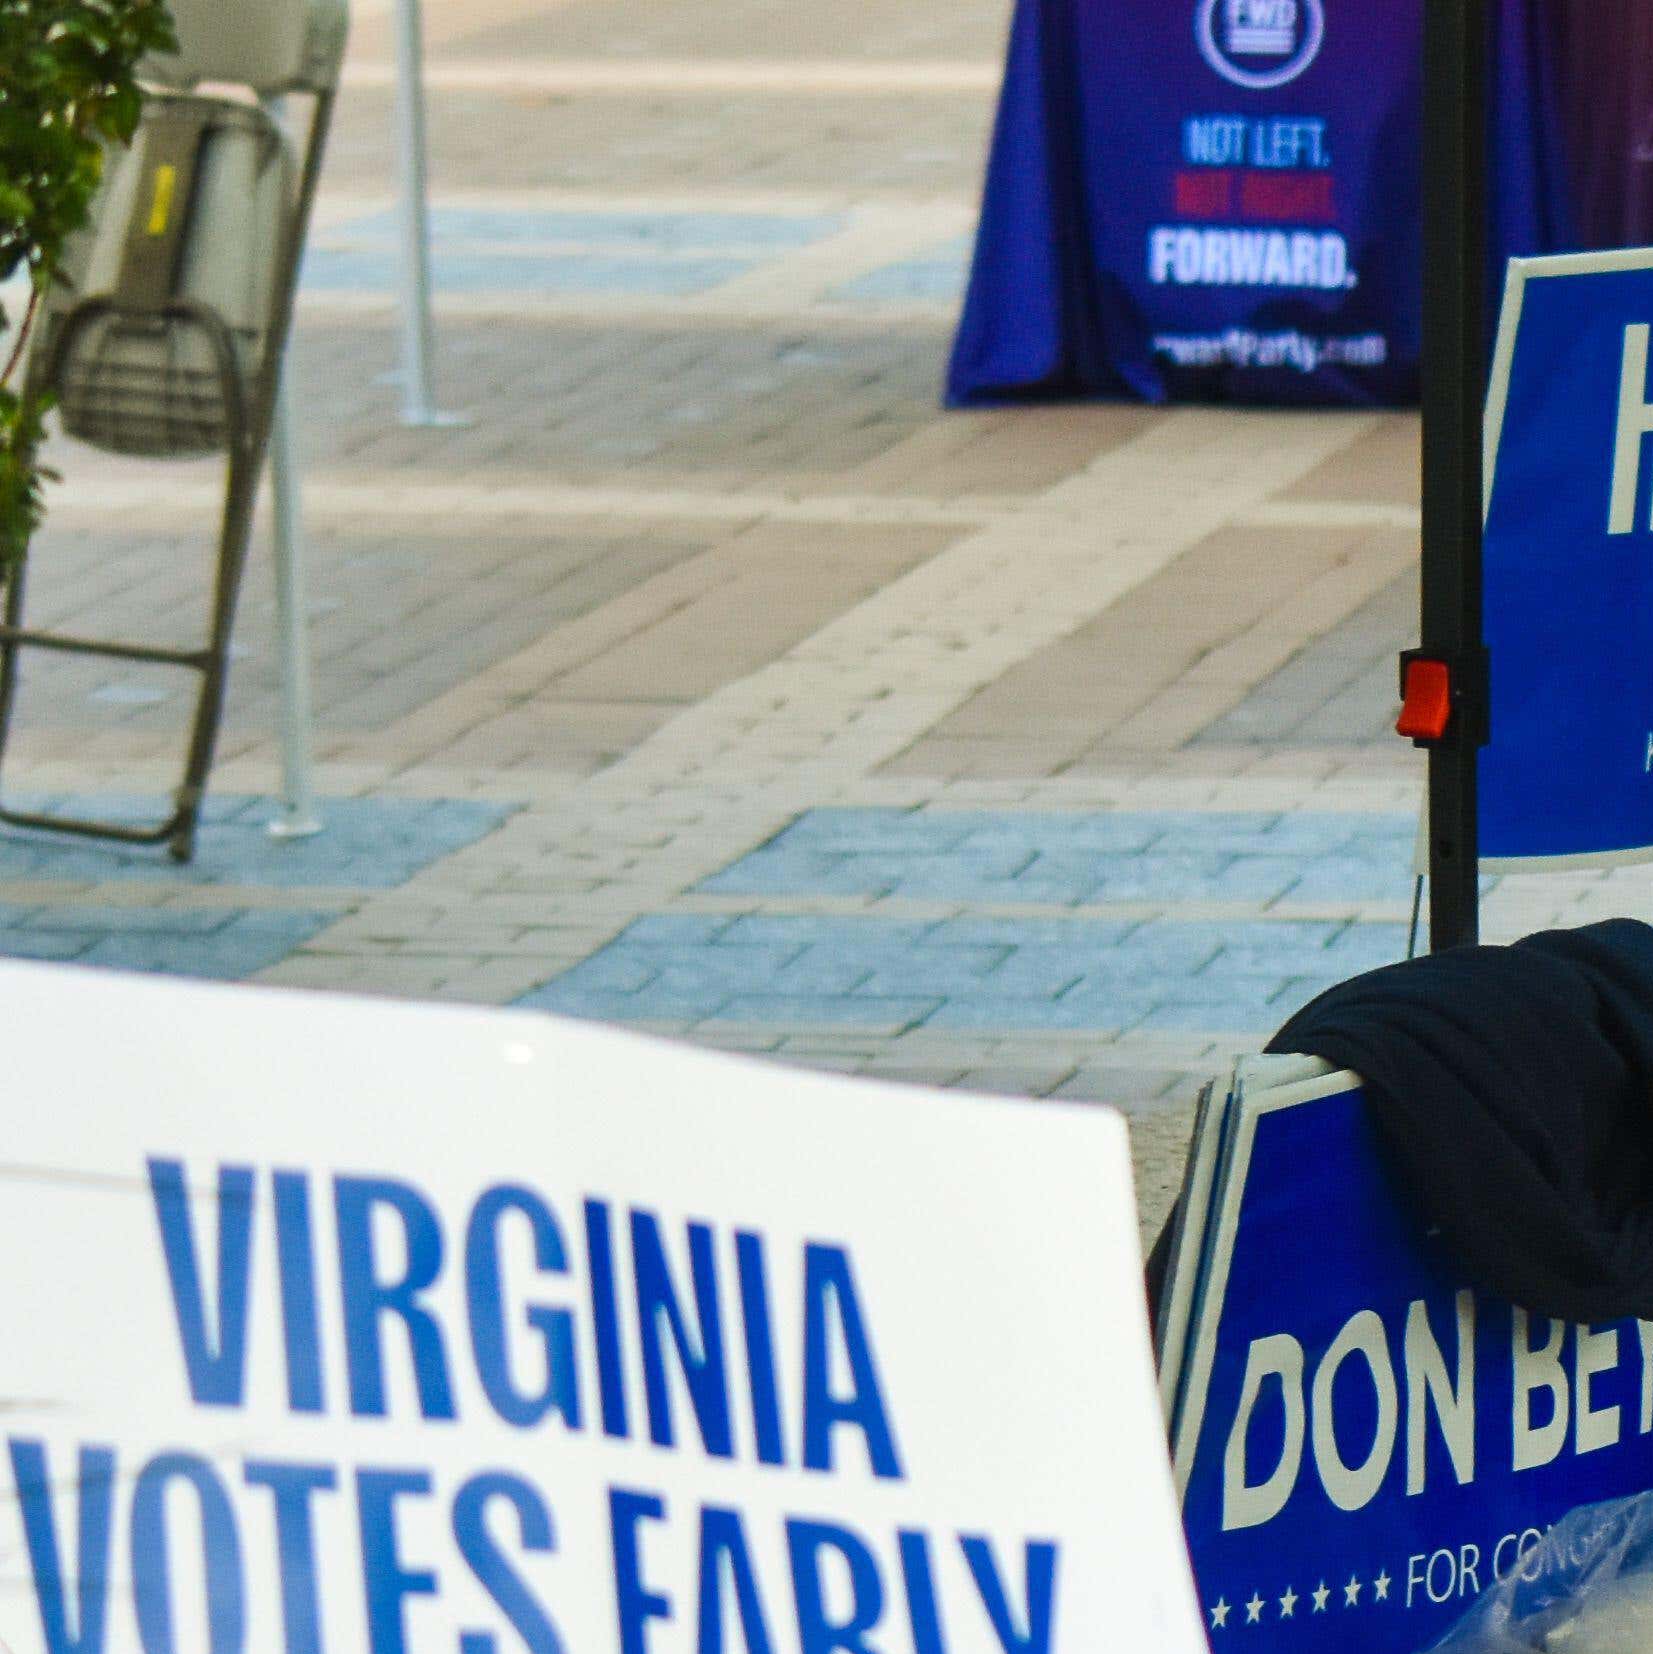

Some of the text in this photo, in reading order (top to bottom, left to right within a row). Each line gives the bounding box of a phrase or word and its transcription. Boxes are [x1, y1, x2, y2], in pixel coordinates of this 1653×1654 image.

[1183, 115, 1247, 166] NOT
[1150, 227, 1359, 289] FORWARD.
[143, 1154, 907, 1482] VIRGINIA
[1222, 1289, 1477, 1533] DON
[1406, 1543, 1480, 1608] FOR
